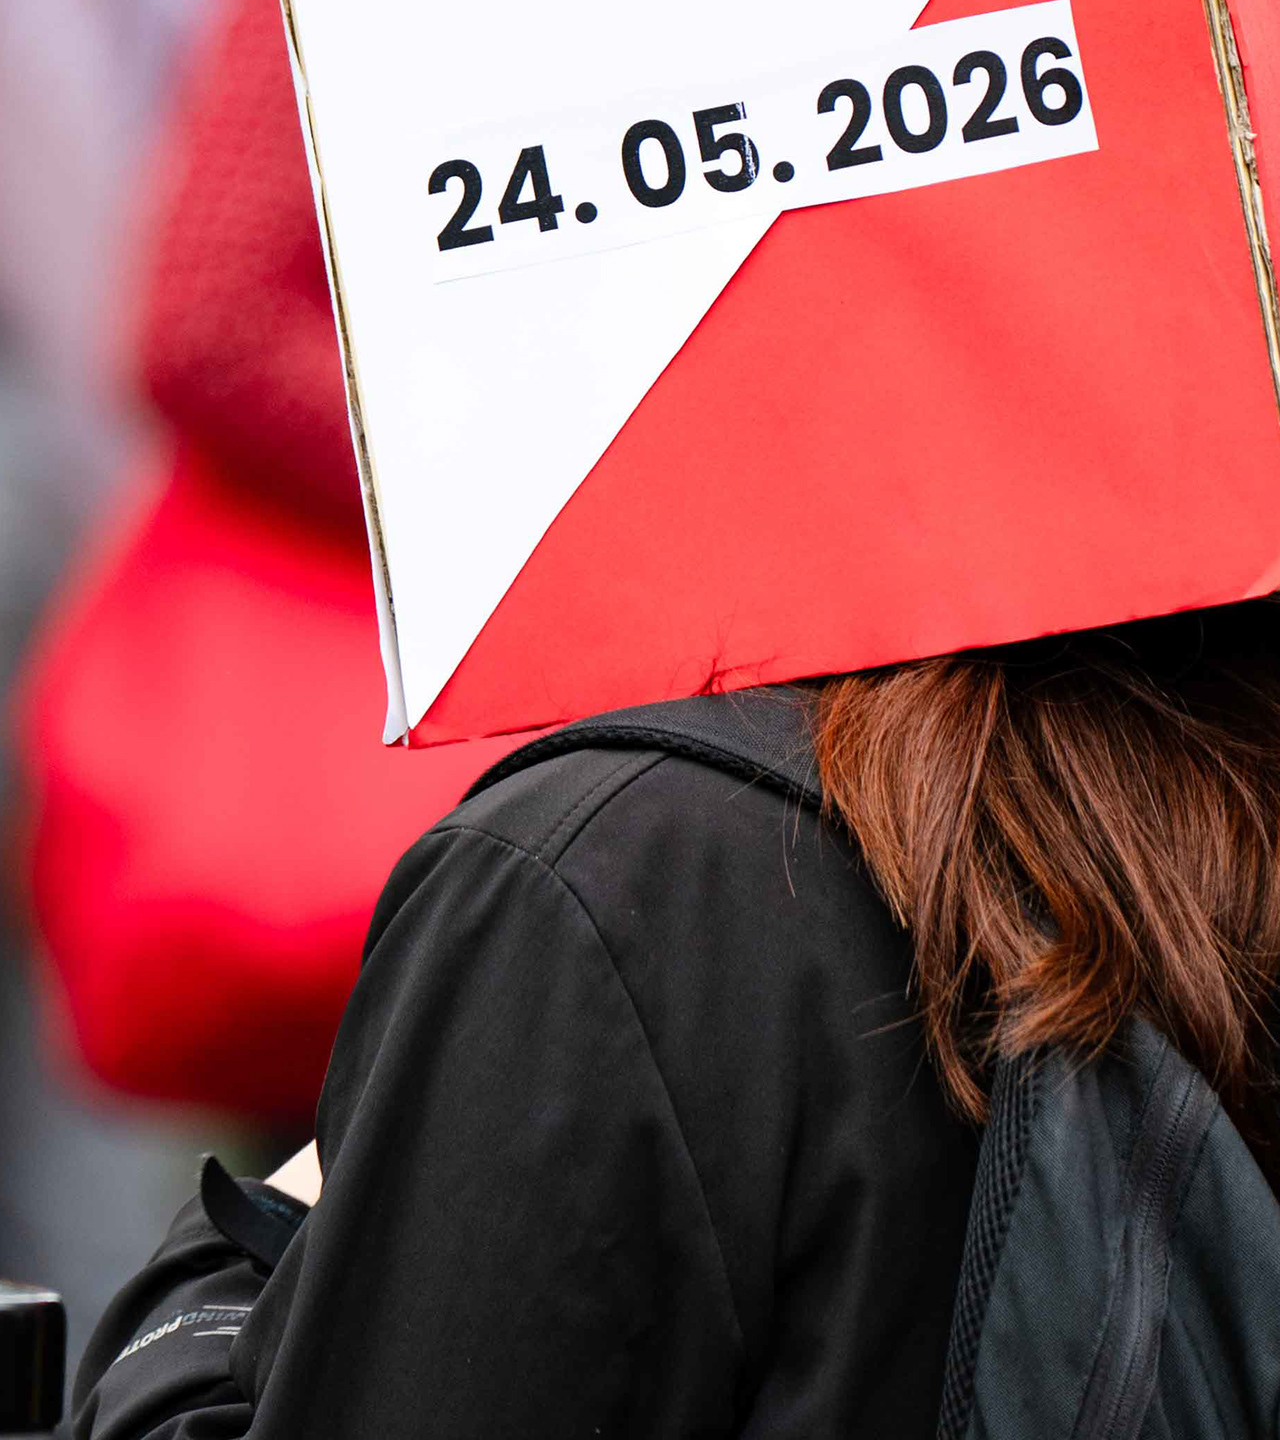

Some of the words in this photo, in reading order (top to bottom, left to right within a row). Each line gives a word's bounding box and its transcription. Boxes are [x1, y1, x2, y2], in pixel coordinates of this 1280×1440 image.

[427, 145, 598, 251] 24.
[622, 101, 795, 208] 05.
[817, 36, 1083, 171] 2026
